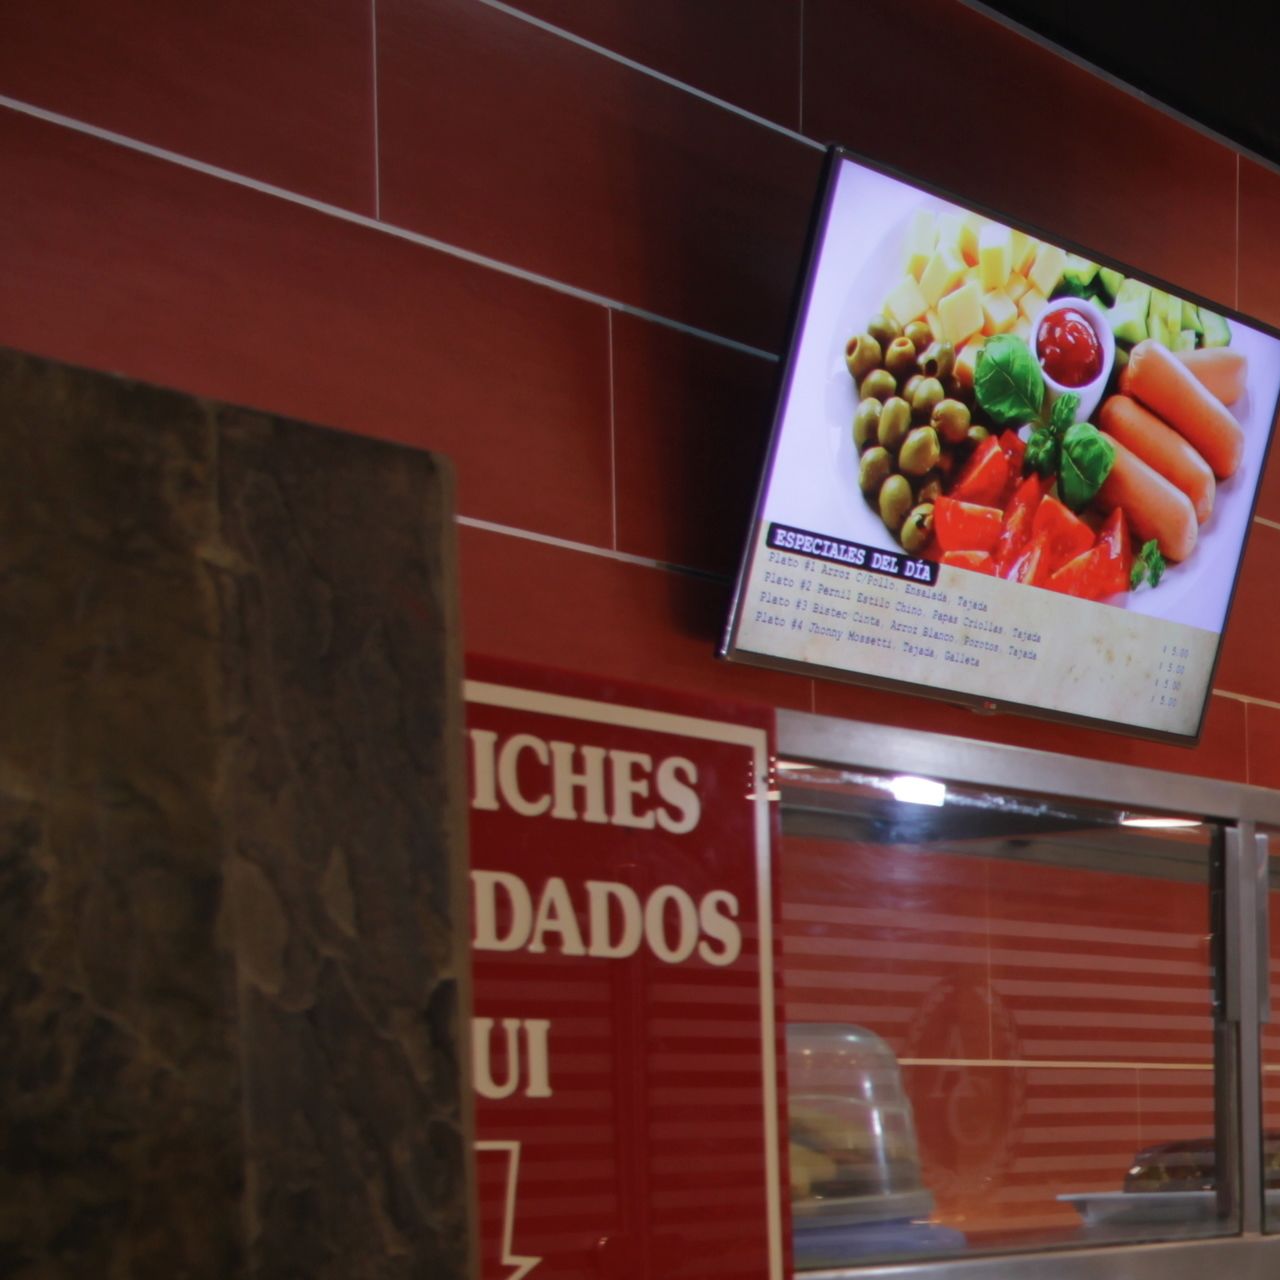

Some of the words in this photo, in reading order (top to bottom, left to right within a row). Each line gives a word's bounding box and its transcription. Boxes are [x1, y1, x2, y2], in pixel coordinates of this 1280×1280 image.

[768, 552, 798, 569] Plato
[804, 561, 814, 572] #1
[821, 565, 850, 580] Arroz
[958, 596, 988, 612] Tajada
[774, 529, 866, 566] ESPECIALES
[872, 552, 898, 572] DEL
[906, 559, 931, 581] DÍA
[755, 611, 785, 628] Plato
[791, 620, 802, 631] #4
[809, 623, 843, 641] Jhonny
[944, 651, 980, 667] Galleta
[760, 592, 790, 608] Plato
[796, 600, 806, 611] #3
[813, 603, 848, 620] Bistec
[891, 620, 917, 636] Arroz
[1009, 646, 1037, 661] Tajada
[765, 572, 795, 588] Plato
[800, 581, 812, 592] #2
[818, 584, 851, 601] Pernil
[857, 594, 890, 609] Estilo
[932, 610, 958, 626] Papas
[1013, 628, 1041, 643] Tajada
[469, 729, 701, 834] ICHES
[471, 870, 742, 966] DADOS
[473, 1018, 552, 1098] UI
